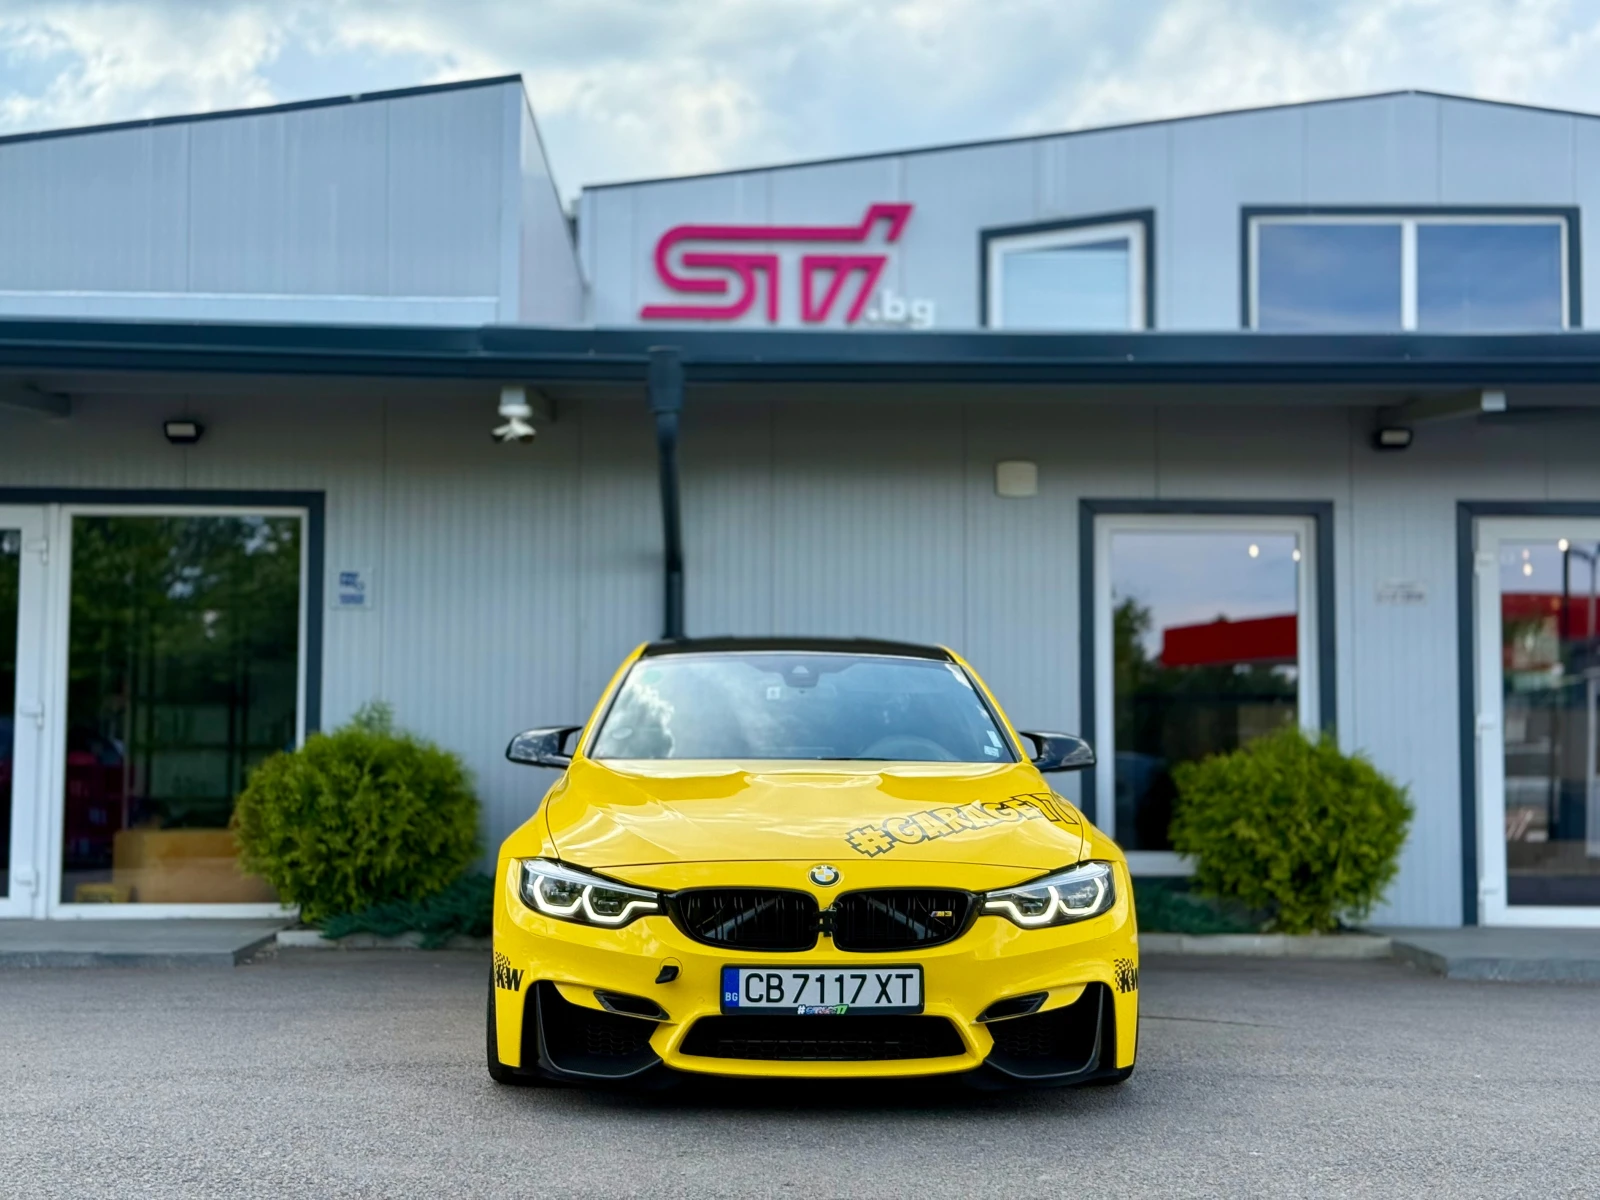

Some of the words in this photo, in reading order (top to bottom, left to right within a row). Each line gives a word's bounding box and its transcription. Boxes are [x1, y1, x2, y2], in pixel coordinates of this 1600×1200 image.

[496, 963, 525, 992] KW
[792, 973, 867, 1004] 7117
[875, 973, 913, 1004] XT
[725, 992, 738, 1001] BG
